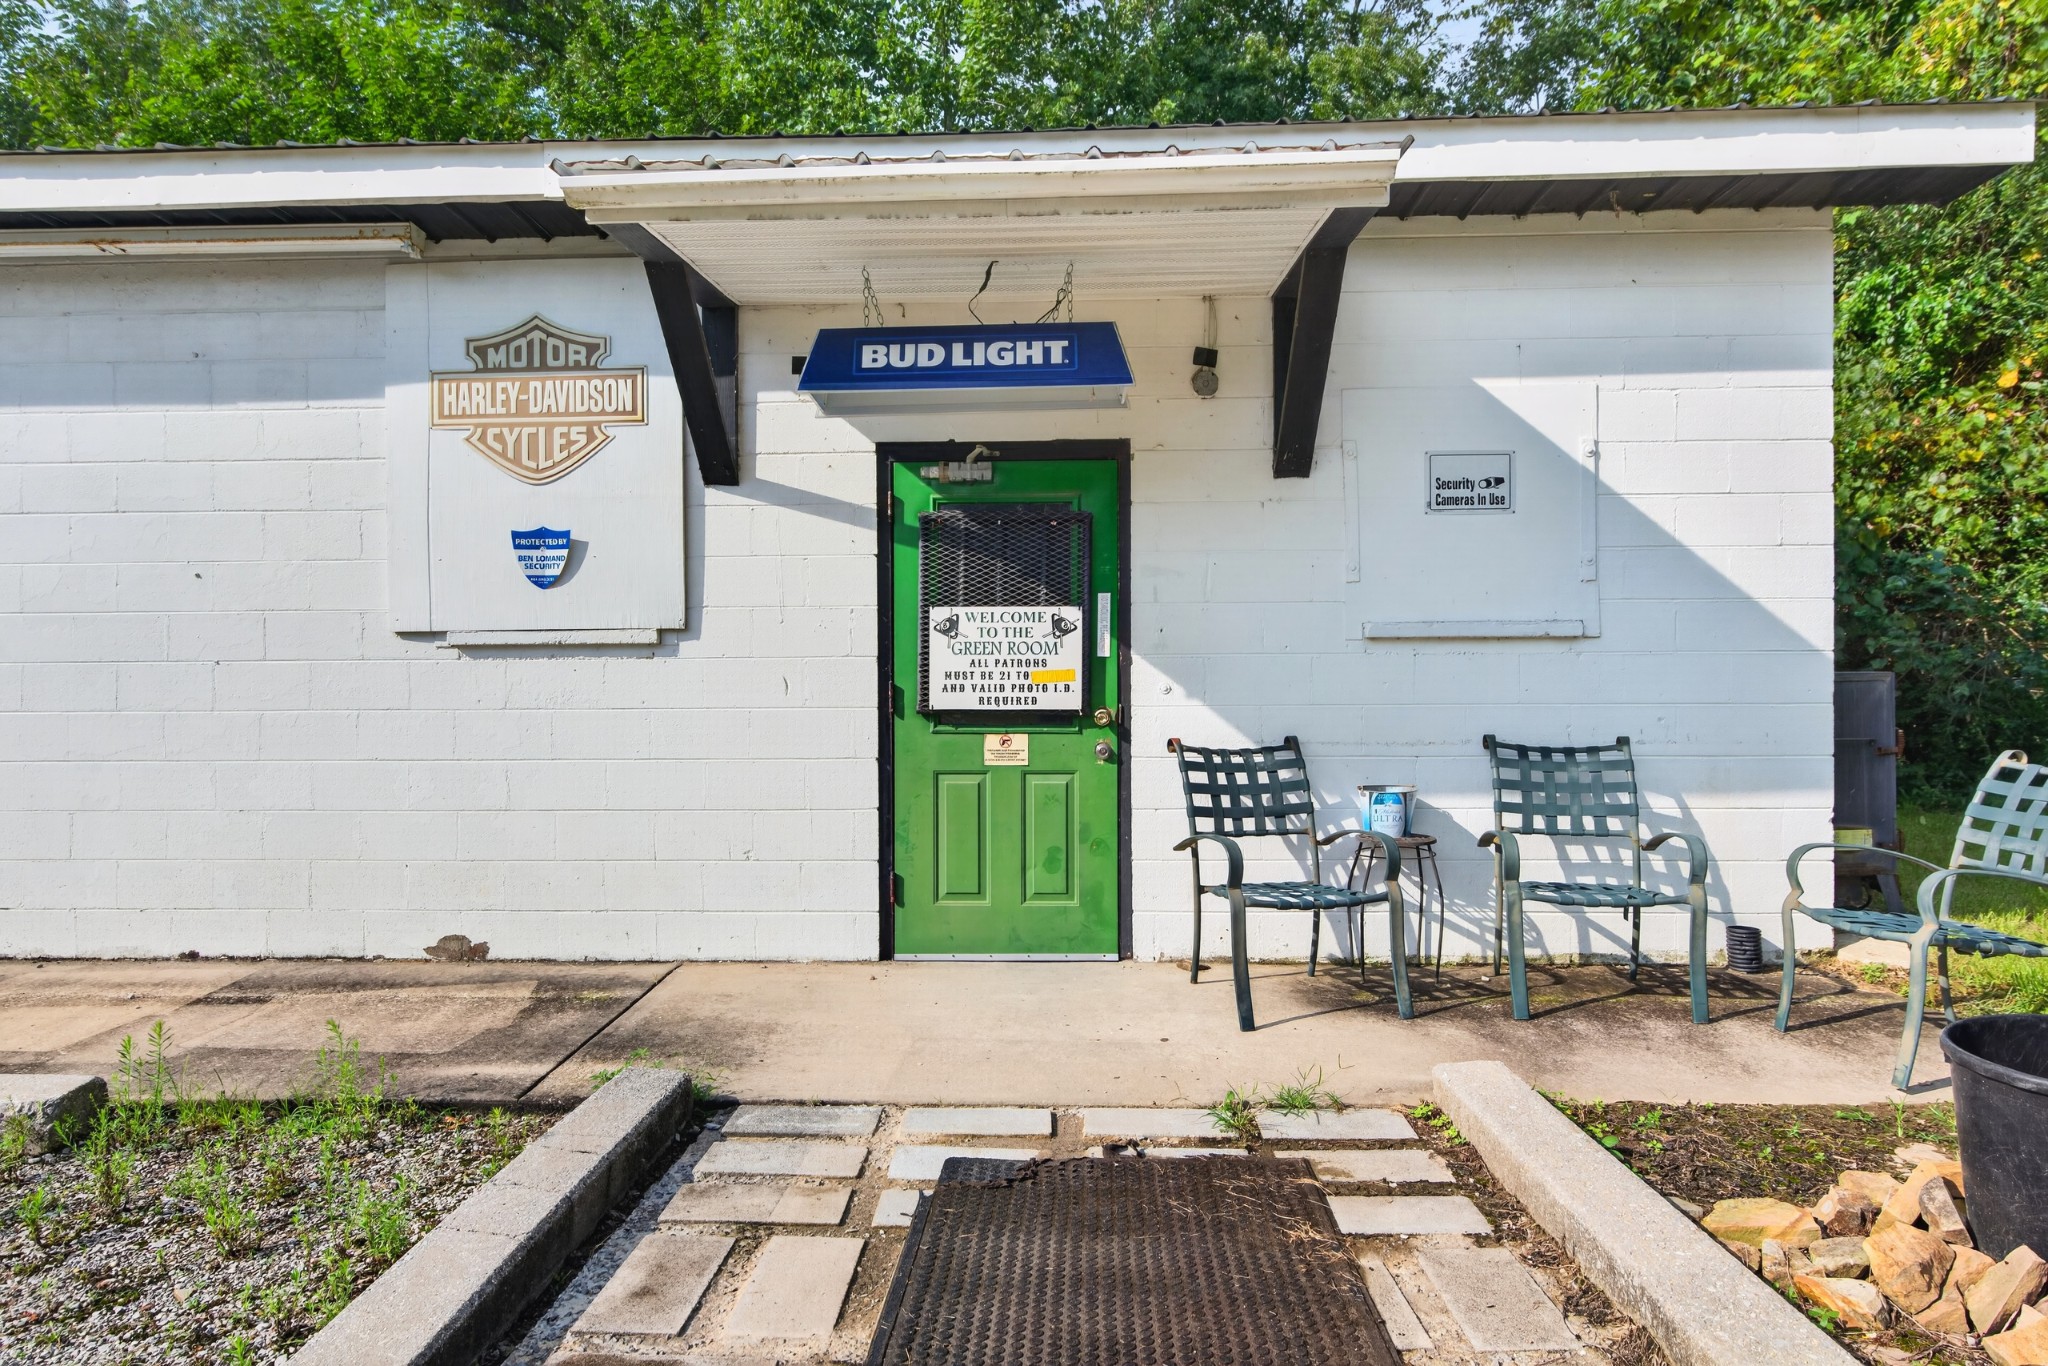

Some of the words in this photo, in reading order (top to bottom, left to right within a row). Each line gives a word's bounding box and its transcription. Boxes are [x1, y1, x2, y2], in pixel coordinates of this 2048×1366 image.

[488, 329, 587, 368] MOTOR
[861, 343, 946, 369] BUD
[443, 378, 634, 416] HARLEY-DAVIDSON
[487, 426, 588, 470] CYCLES
[1435, 477, 1475, 492] Security
[1435, 493, 1475, 506] Cameras
[1478, 493, 1486, 506] In
[1489, 493, 1505, 506] Use
[524, 562, 561, 570] SECURITY
[964, 611, 1047, 624] WELCOME
[977, 627, 998, 638] TO
[1002, 627, 1034, 638] THE
[951, 641, 1002, 656] GREEN
[1007, 641, 1060, 656] ROOM
[969, 658, 989, 668] ALL
[994, 658, 1048, 668] PATRONS
[944, 671, 975, 681] MUST
[980, 671, 994, 681] BE
[999, 671, 1011, 681] 21
[1016, 671, 1030, 681] TO
[941, 683, 966, 693] AND
[971, 683, 1006, 693] VALID
[1011, 683, 1049, 693] PHOTO
[1054, 683, 1076, 693] I.D.
[978, 696, 1038, 707] REQUIRED
